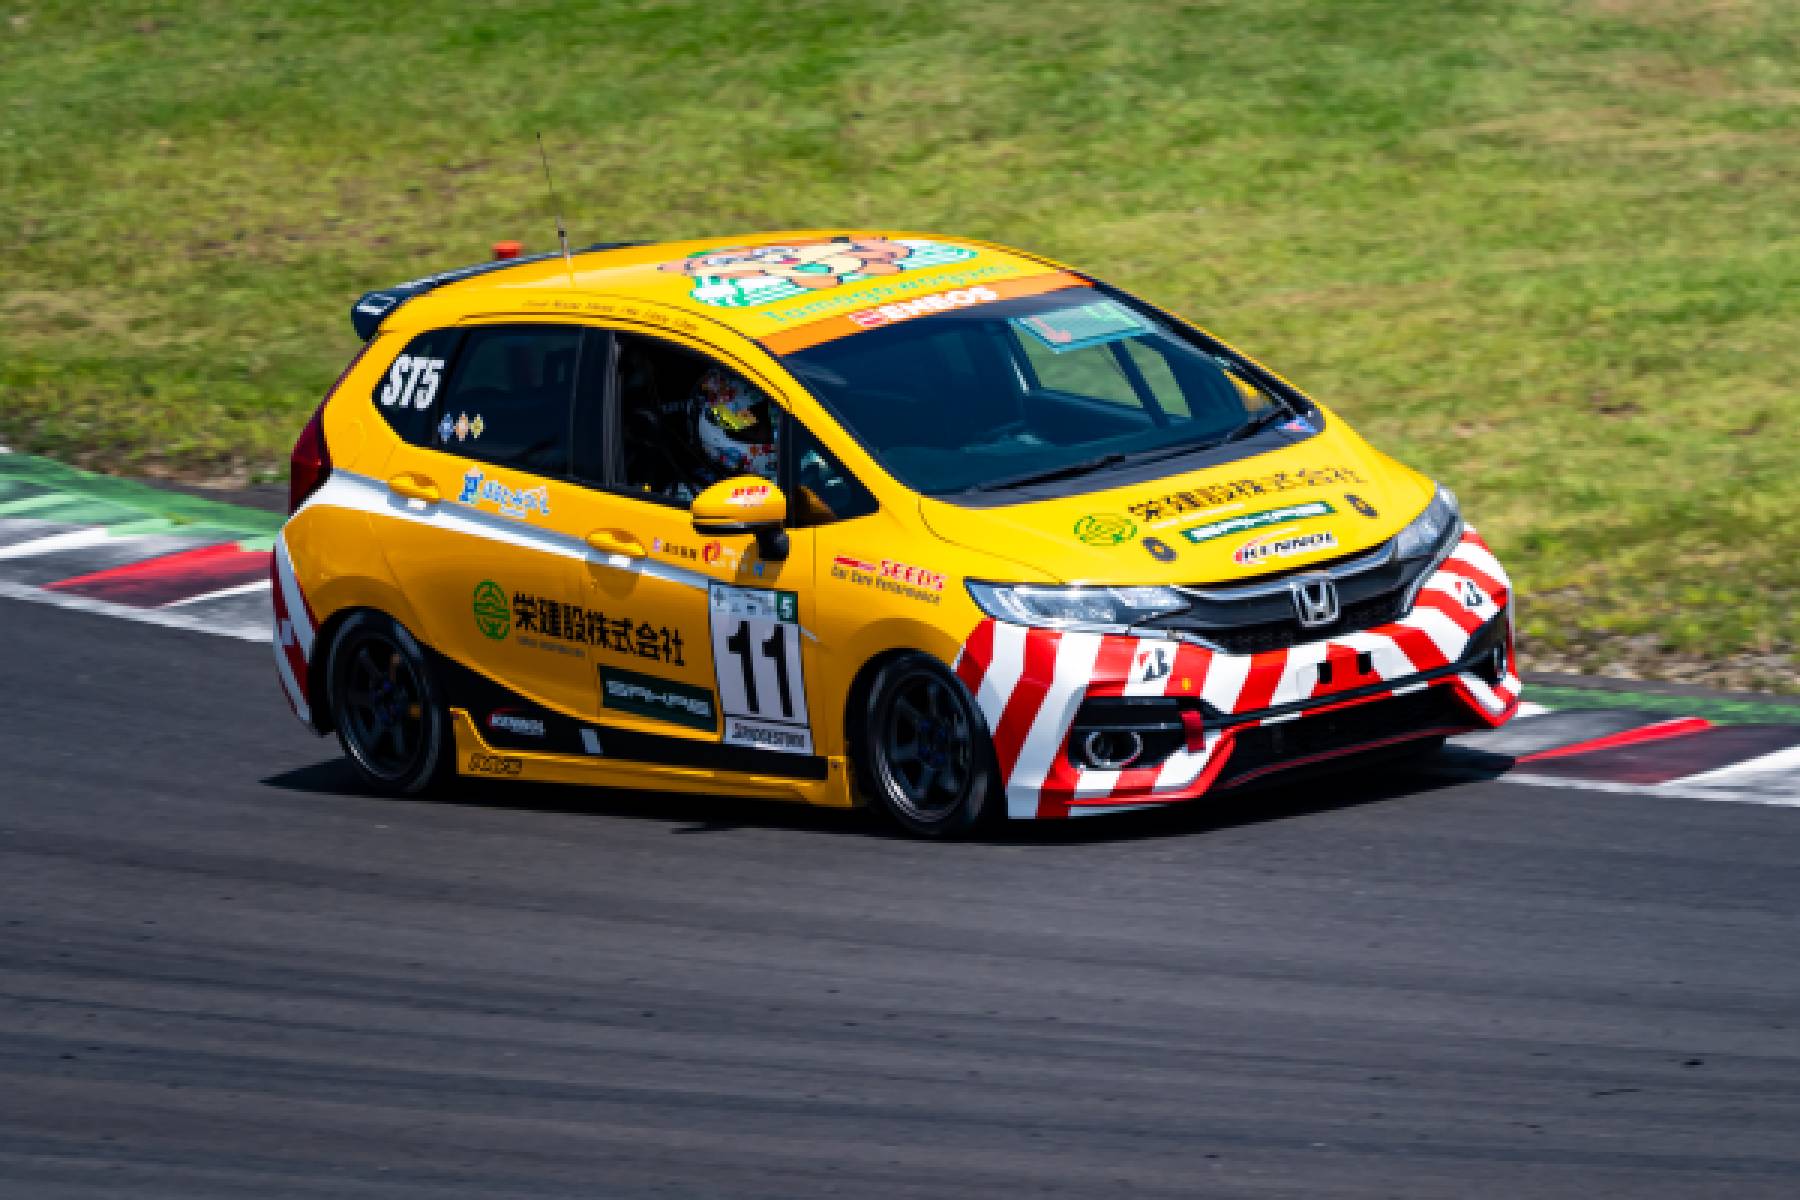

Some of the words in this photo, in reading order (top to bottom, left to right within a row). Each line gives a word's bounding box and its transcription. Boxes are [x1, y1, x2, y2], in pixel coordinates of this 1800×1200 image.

[883, 285, 998, 321] ENEOS
[379, 352, 446, 410] ST5
[879, 558, 948, 593] SEEDS
[513, 591, 686, 667] 栄建設株式会社
[780, 594, 794, 620] 5
[726, 620, 795, 717] 11
